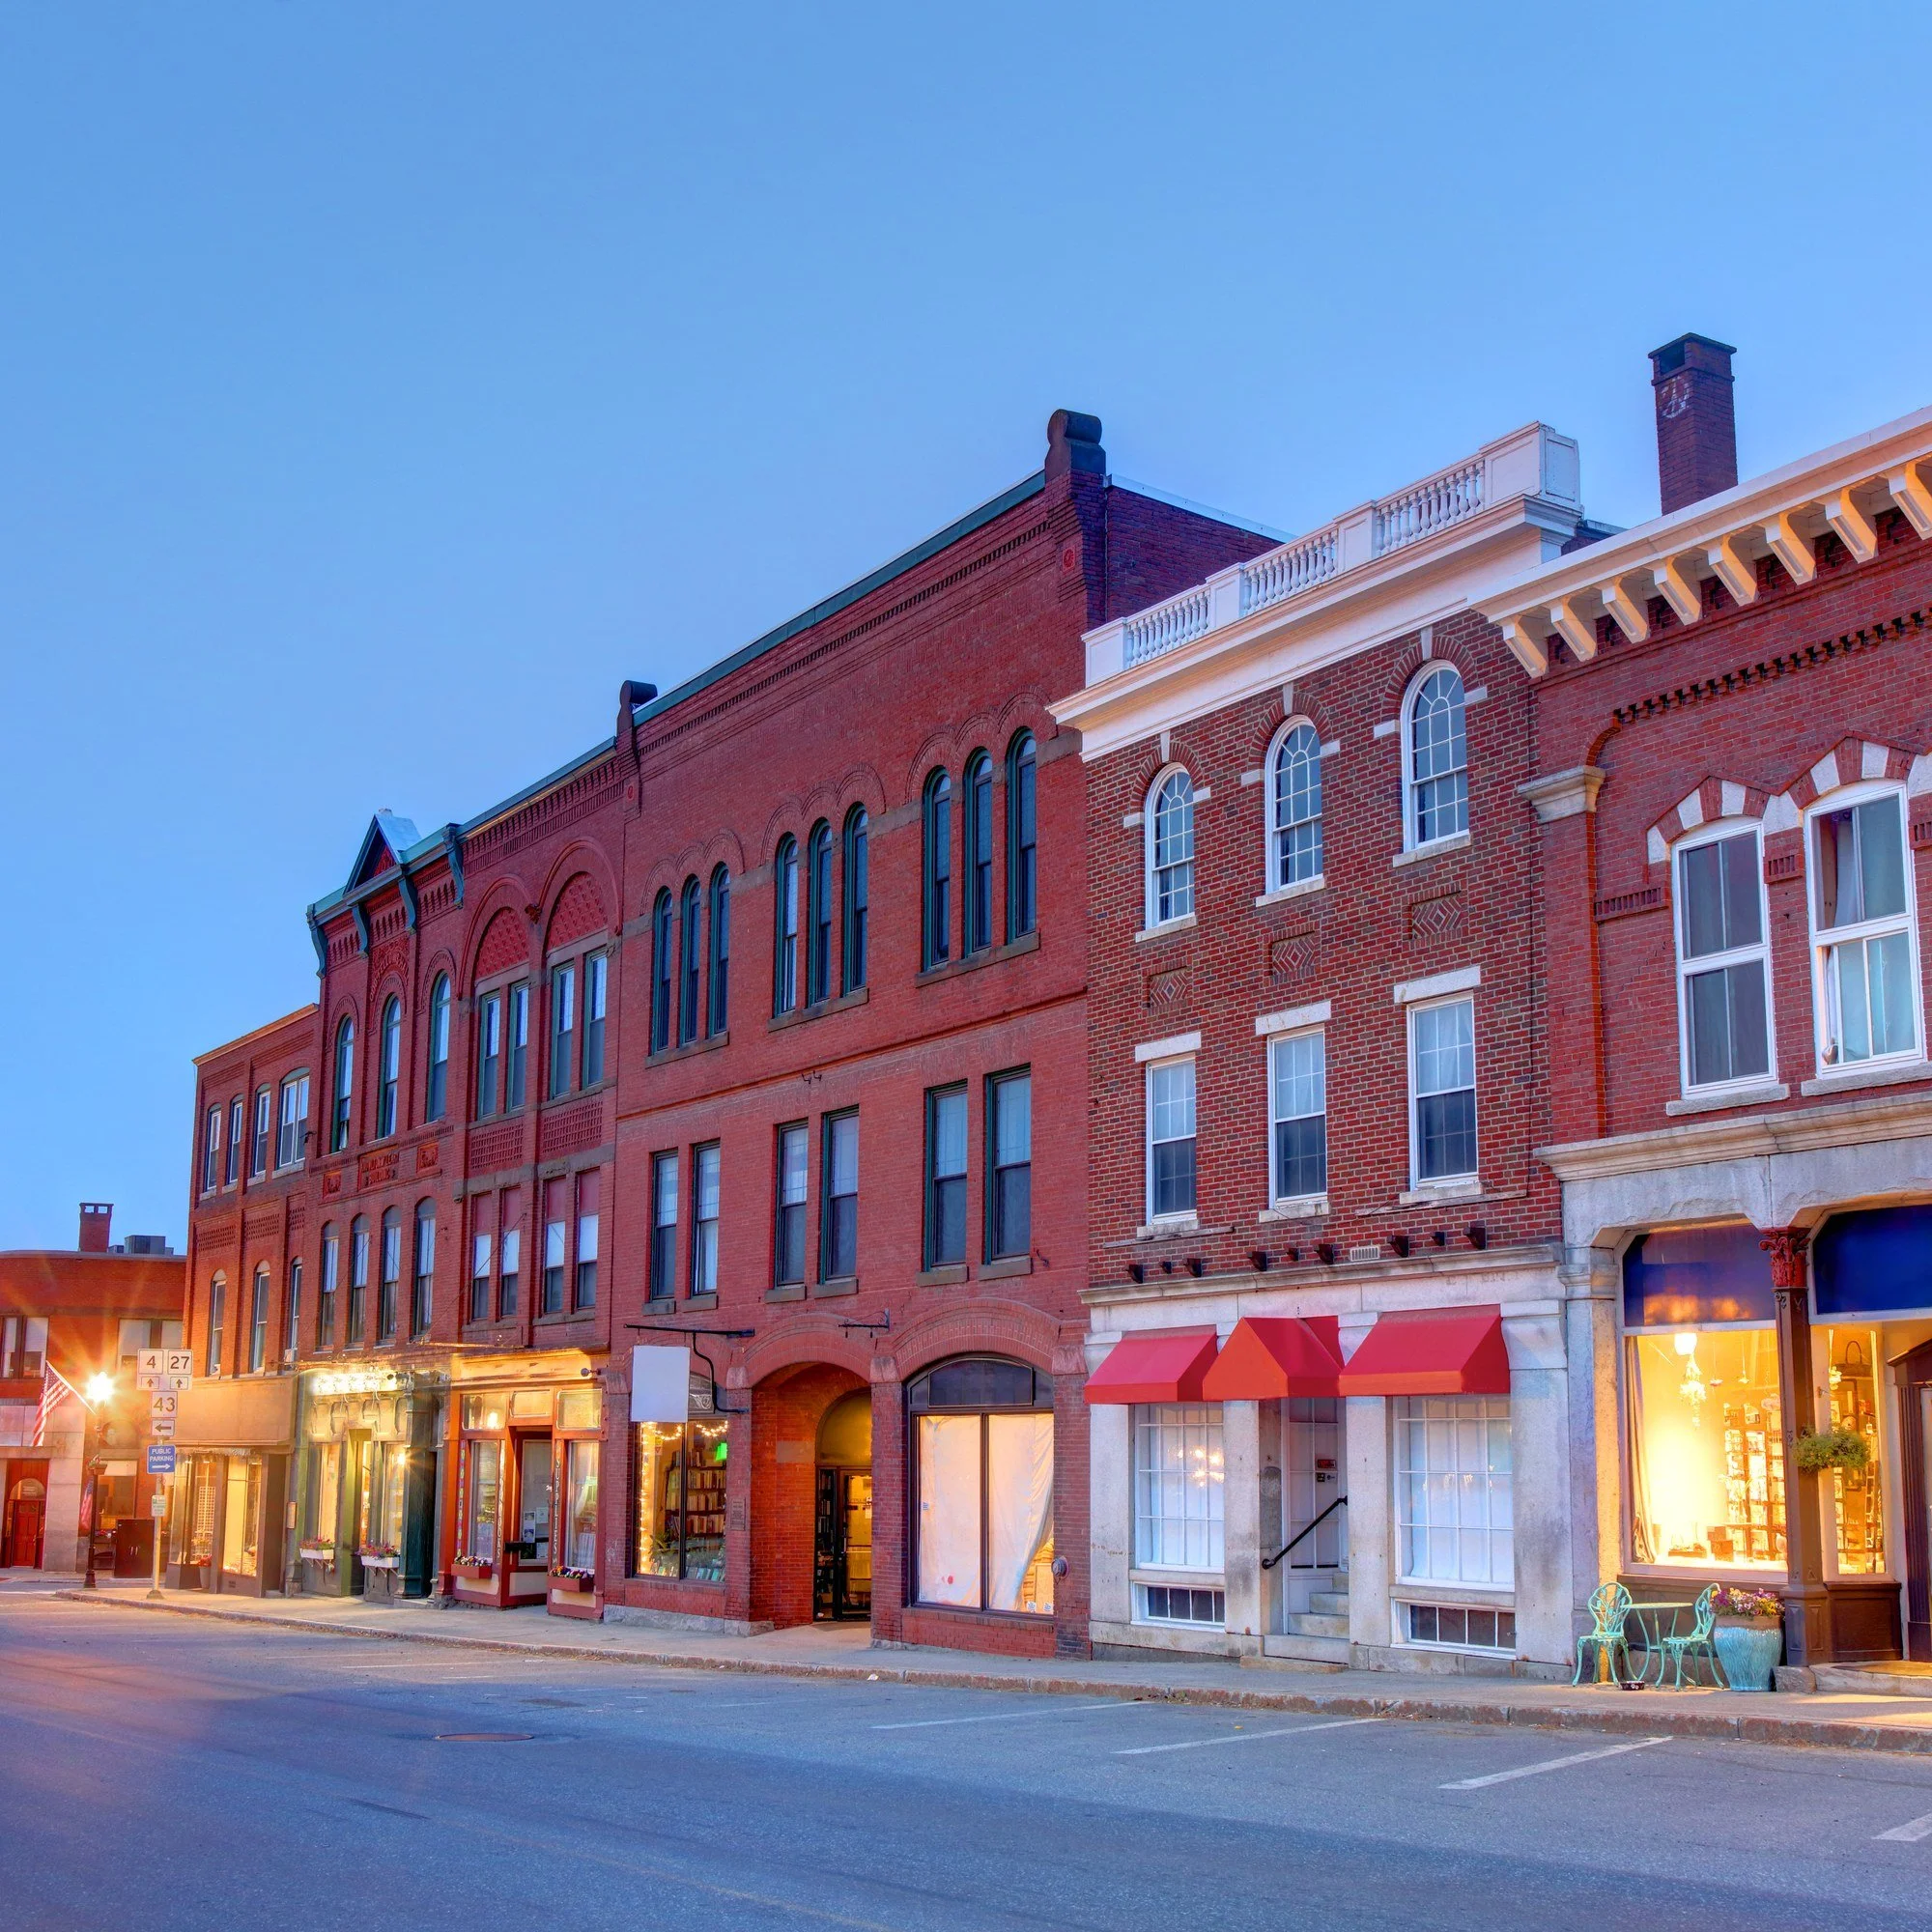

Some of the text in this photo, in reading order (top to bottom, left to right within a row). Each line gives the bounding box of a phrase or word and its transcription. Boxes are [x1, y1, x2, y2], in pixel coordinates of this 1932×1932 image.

[146, 1355, 156, 1369] 4
[170, 1355, 190, 1370] 27
[153, 1397, 176, 1412] 43
